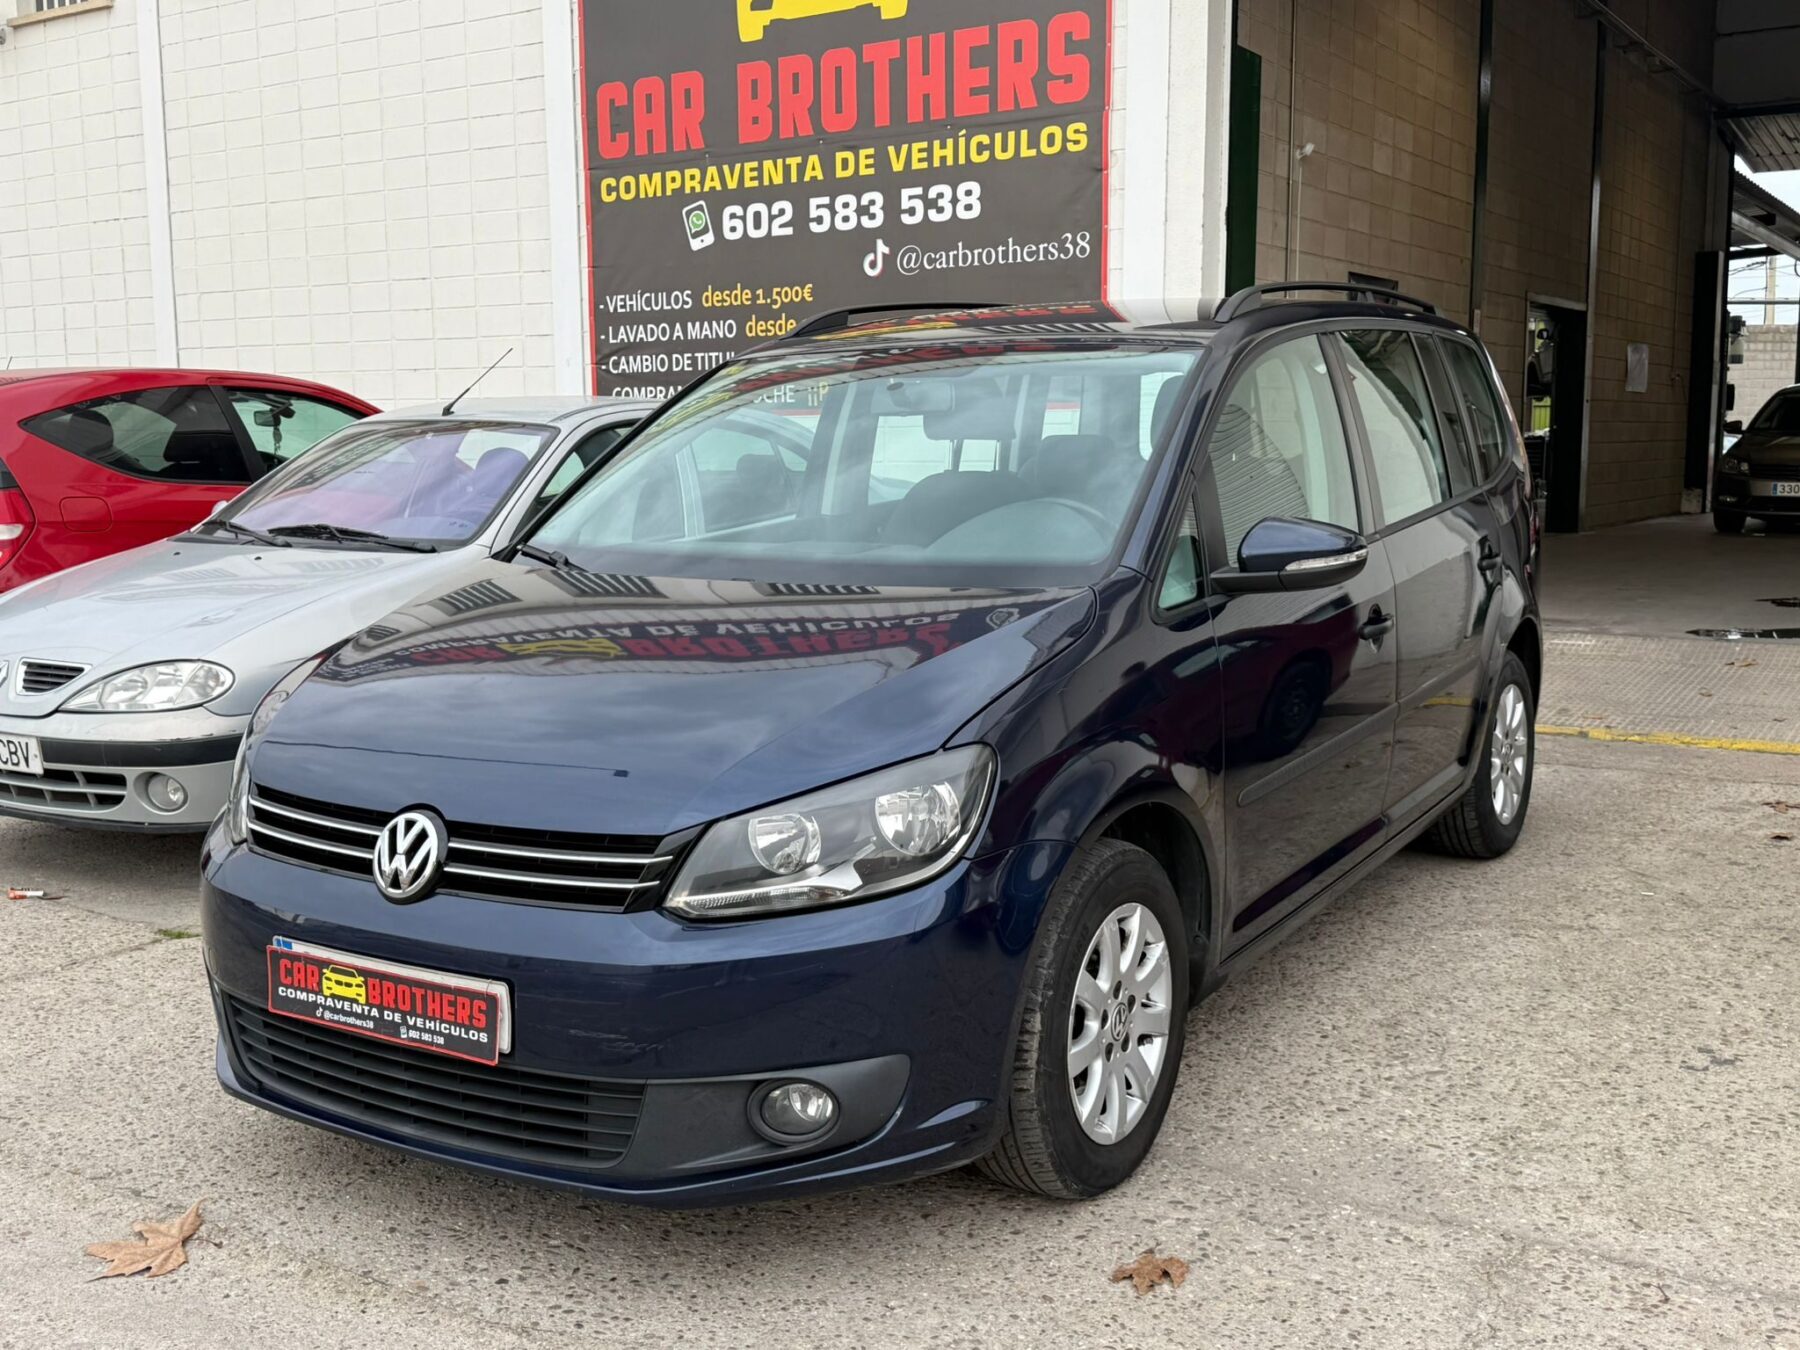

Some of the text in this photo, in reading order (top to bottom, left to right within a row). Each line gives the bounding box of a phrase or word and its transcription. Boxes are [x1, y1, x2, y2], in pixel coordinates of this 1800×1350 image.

[597, 10, 1091, 160] CAR BROTHERS
[600, 122, 1089, 203] COMPRAVENTA DE VEHÍCULOS
[722, 181, 982, 240] 602 583 538
[896, 231, 1091, 276] @carbrothers38
[702, 283, 752, 308] desde
[756, 283, 813, 309] 1.500€
[672, 322, 684, 341] A
[687, 319, 737, 341] MANO
[673, 353, 692, 371] DE
[612, 385, 683, 400] COMPRA
[278, 986, 488, 1043] COMPRAVENTA DE VEHÍCULOS
[279, 958, 488, 1029] CAR BROTHERS
[323, 1010, 374, 1029] @carbrothers38
